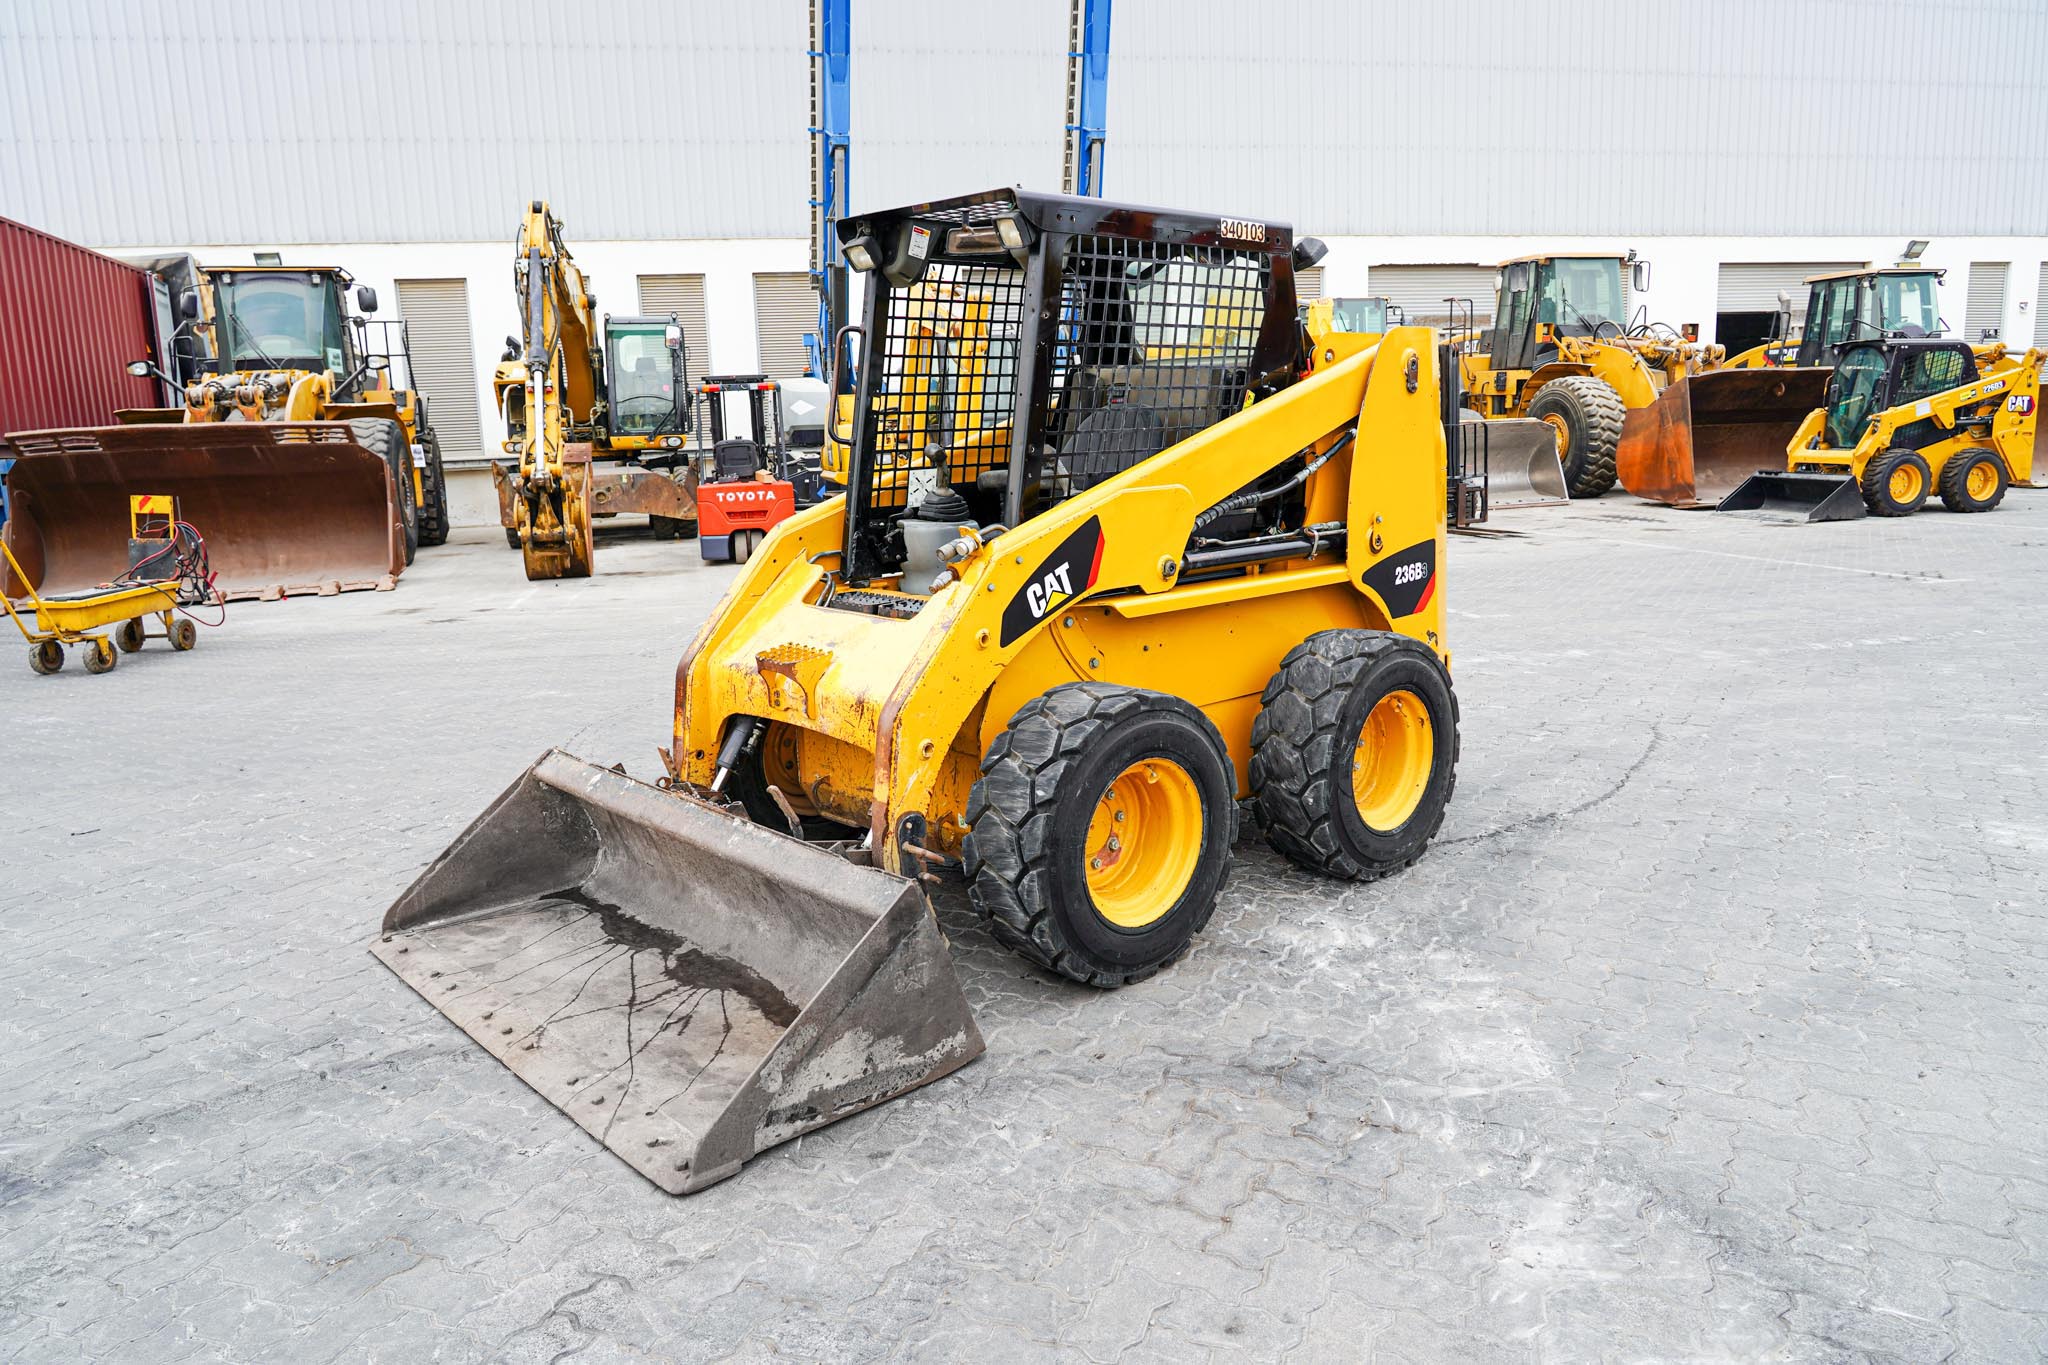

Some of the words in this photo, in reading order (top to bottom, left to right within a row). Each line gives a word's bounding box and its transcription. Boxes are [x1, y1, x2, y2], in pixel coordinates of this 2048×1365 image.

[1221, 220, 1264, 241] 340103
[1780, 348, 1799, 361] CAT
[2008, 396, 2031, 412] CAT
[716, 490, 776, 502] TOYOTA
[1026, 561, 1073, 618] CAT
